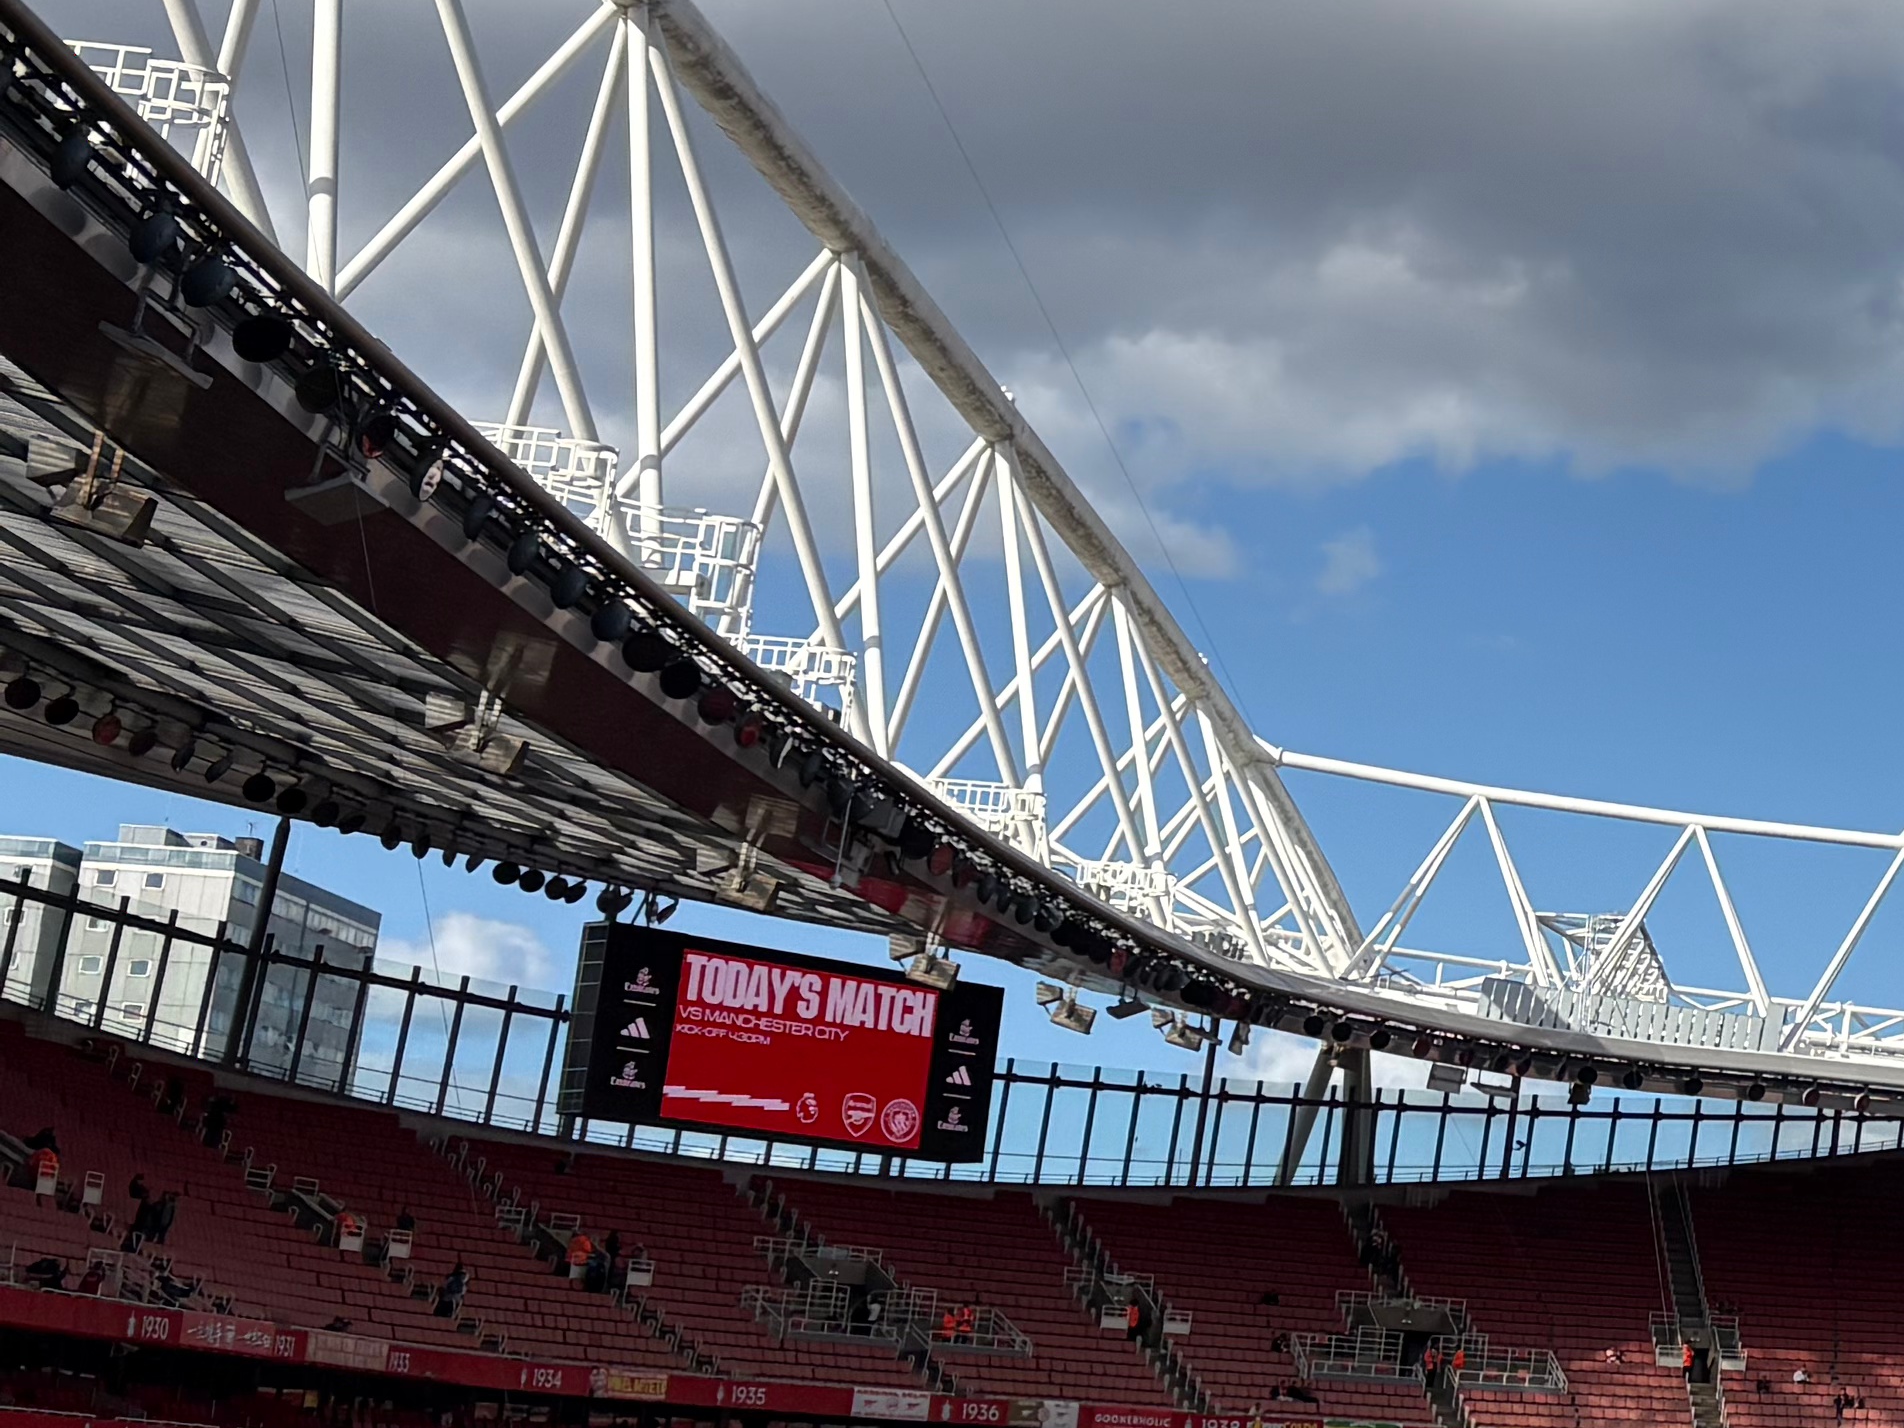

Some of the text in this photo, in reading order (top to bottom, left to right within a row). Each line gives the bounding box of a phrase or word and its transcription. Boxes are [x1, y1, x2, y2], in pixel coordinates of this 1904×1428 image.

[686, 954, 936, 1038] TODAY'S MATCH
[676, 1023, 727, 1037] KICK-OFF
[679, 1004, 849, 1042] VS MANCHESTER CITY
[140, 1315, 169, 1340] 1930
[275, 1333, 295, 1357] 1931
[533, 1367, 562, 1388] 1934
[732, 1385, 766, 1404] 1935
[962, 1404, 999, 1420] 1936
